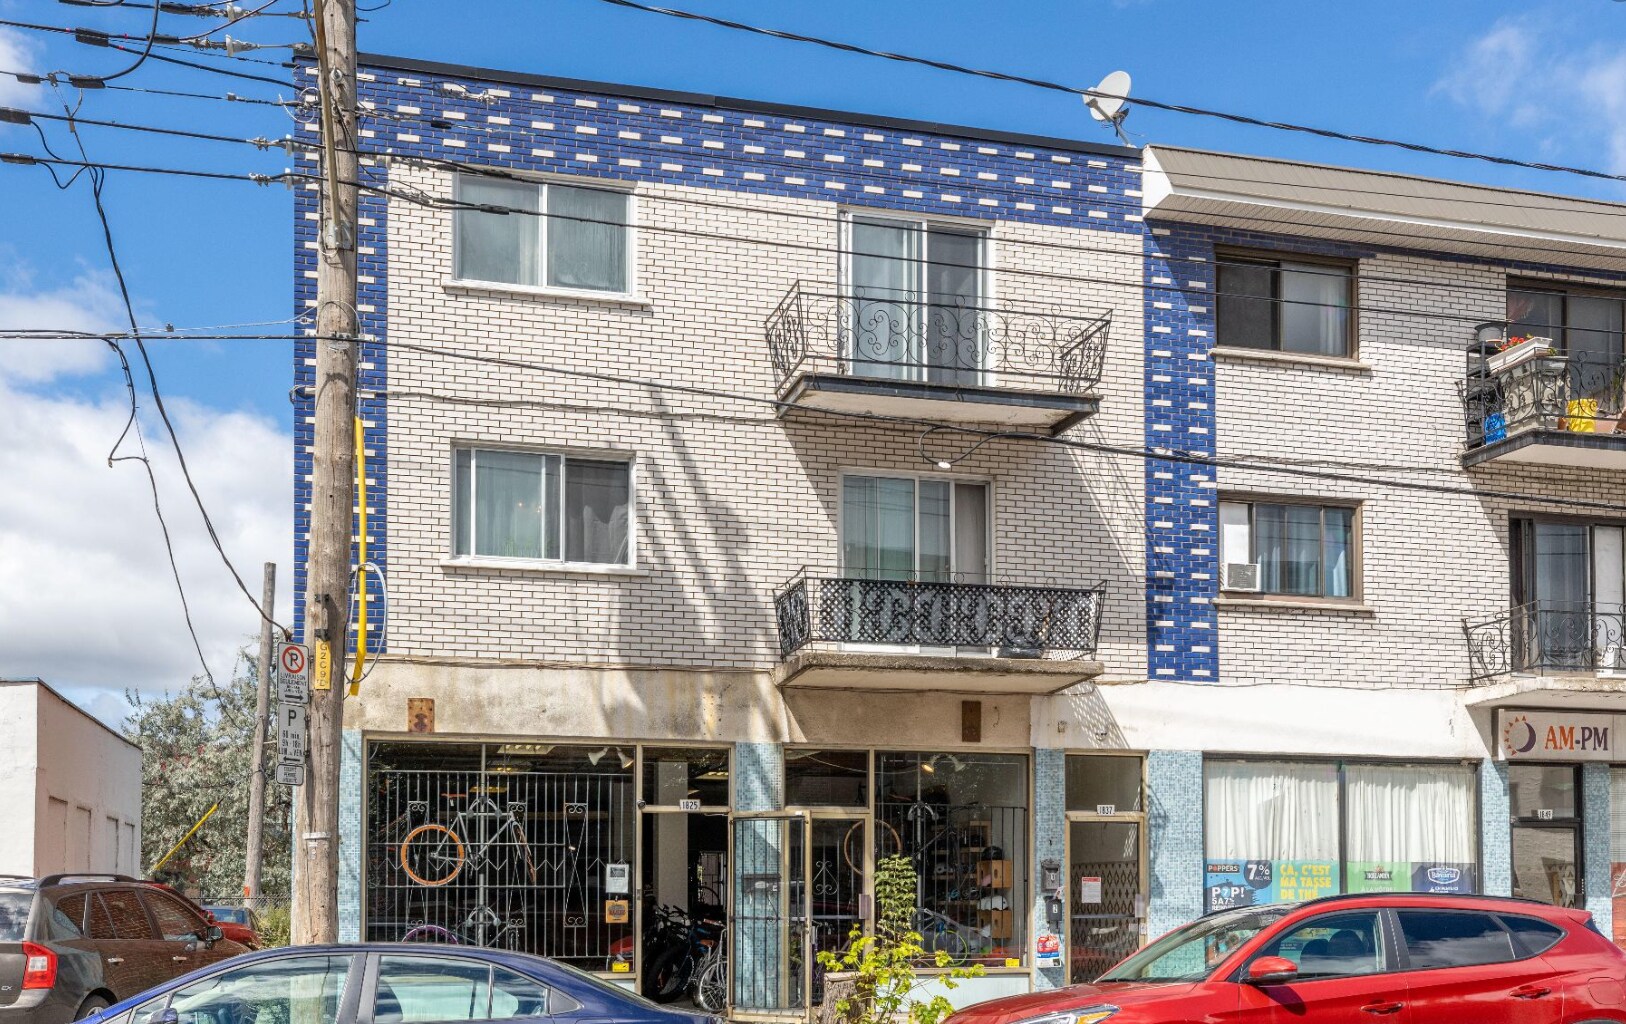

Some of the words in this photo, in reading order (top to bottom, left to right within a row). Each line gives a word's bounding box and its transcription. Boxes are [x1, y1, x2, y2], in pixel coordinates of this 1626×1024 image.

[288, 709, 297, 727] P
[1544, 725, 1609, 751] AM-PM
[682, 801, 698, 810] 1825
[1099, 806, 1113, 815] 1837
[1301, 864, 1331, 875] C'EST
[1280, 876, 1298, 887] MA
[1300, 876, 1332, 888] TASSE
[1280, 888, 1295, 900] DE
